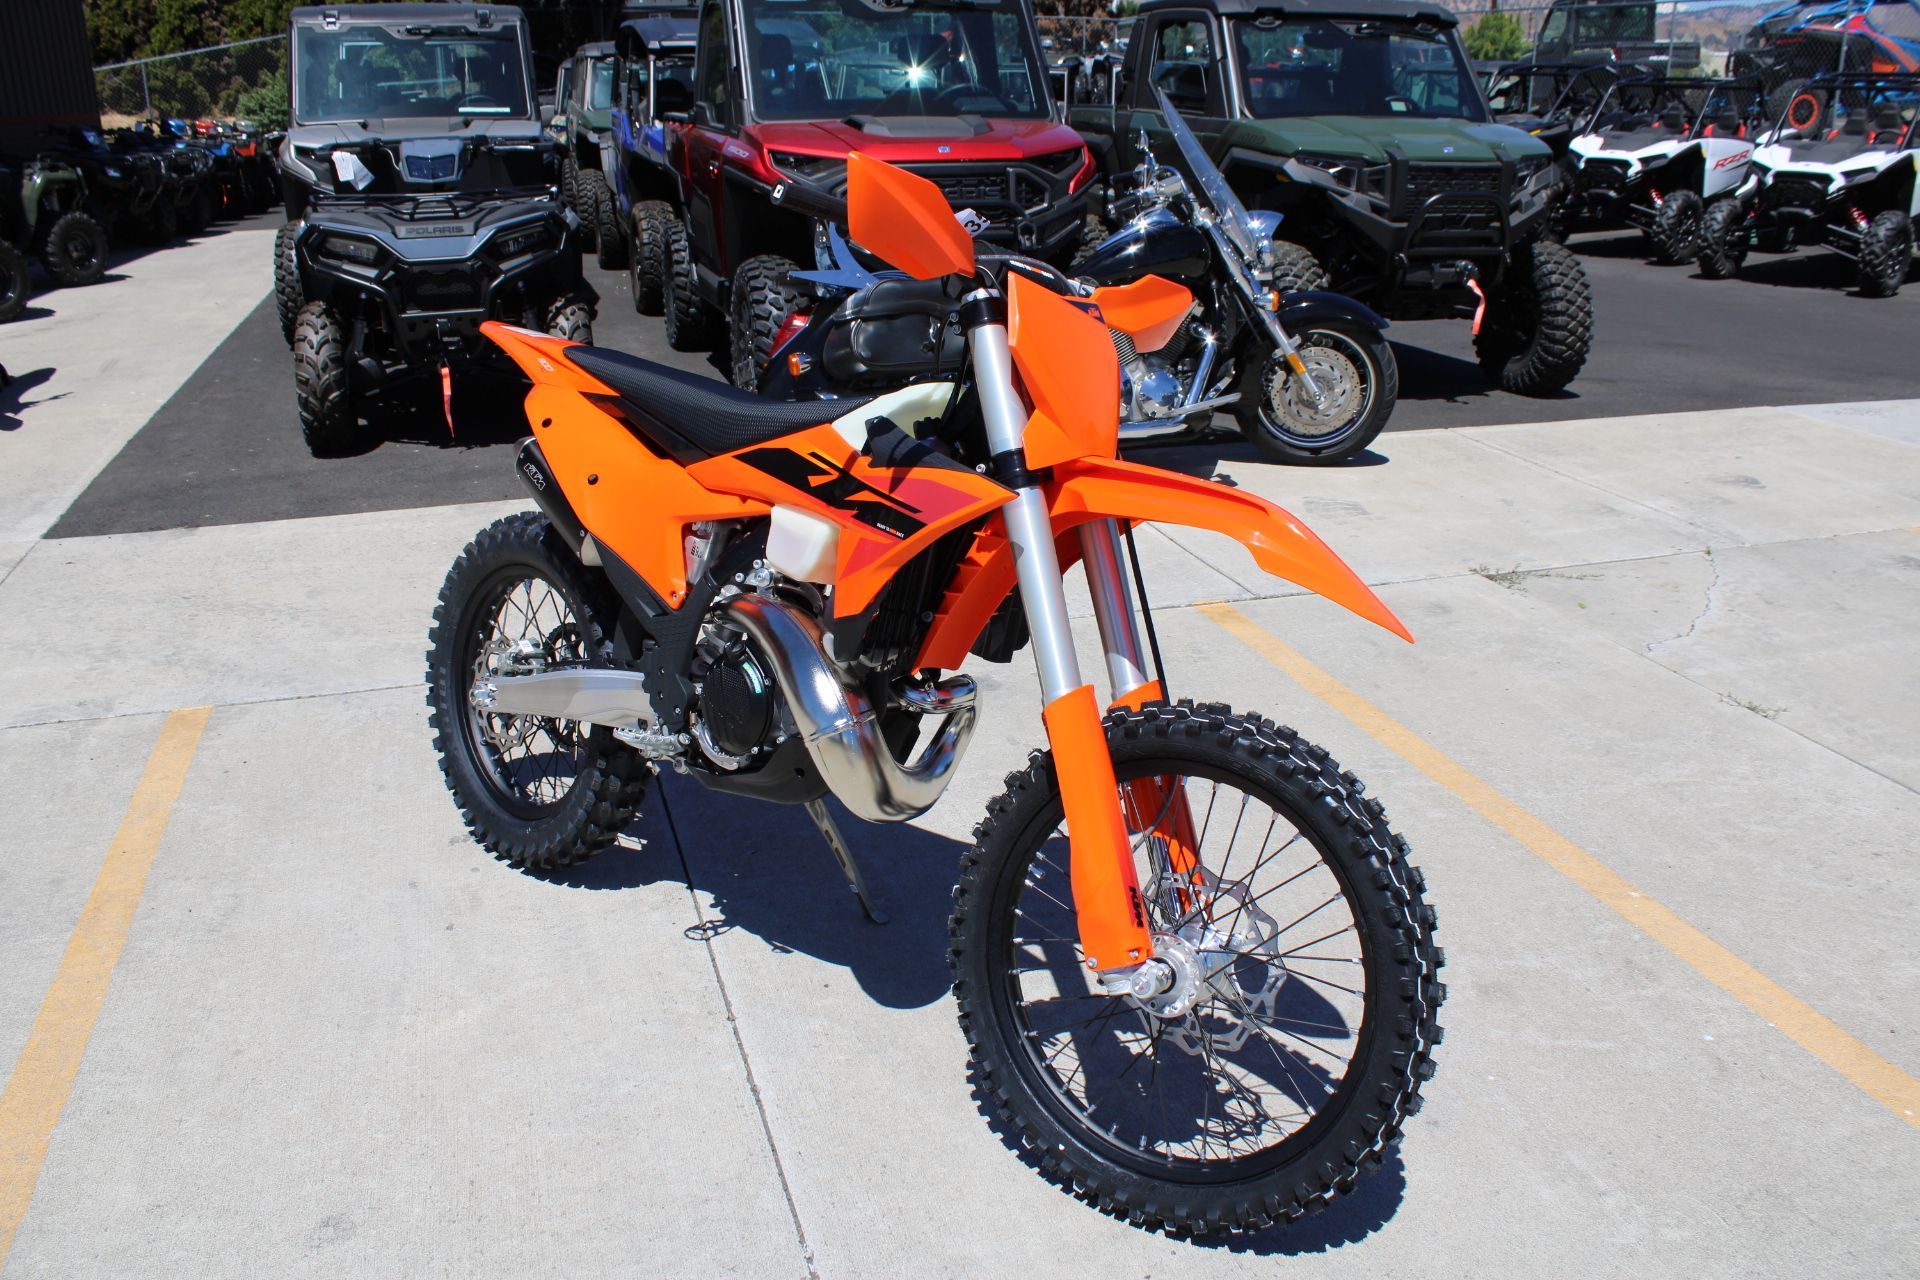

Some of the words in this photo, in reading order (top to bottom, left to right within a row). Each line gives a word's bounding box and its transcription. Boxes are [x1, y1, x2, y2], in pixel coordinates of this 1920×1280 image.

[1712, 149, 1750, 170] RZR
[405, 225, 465, 239] POLARIS
[523, 462, 546, 490] KTM
[1129, 886, 1144, 928] KTM
